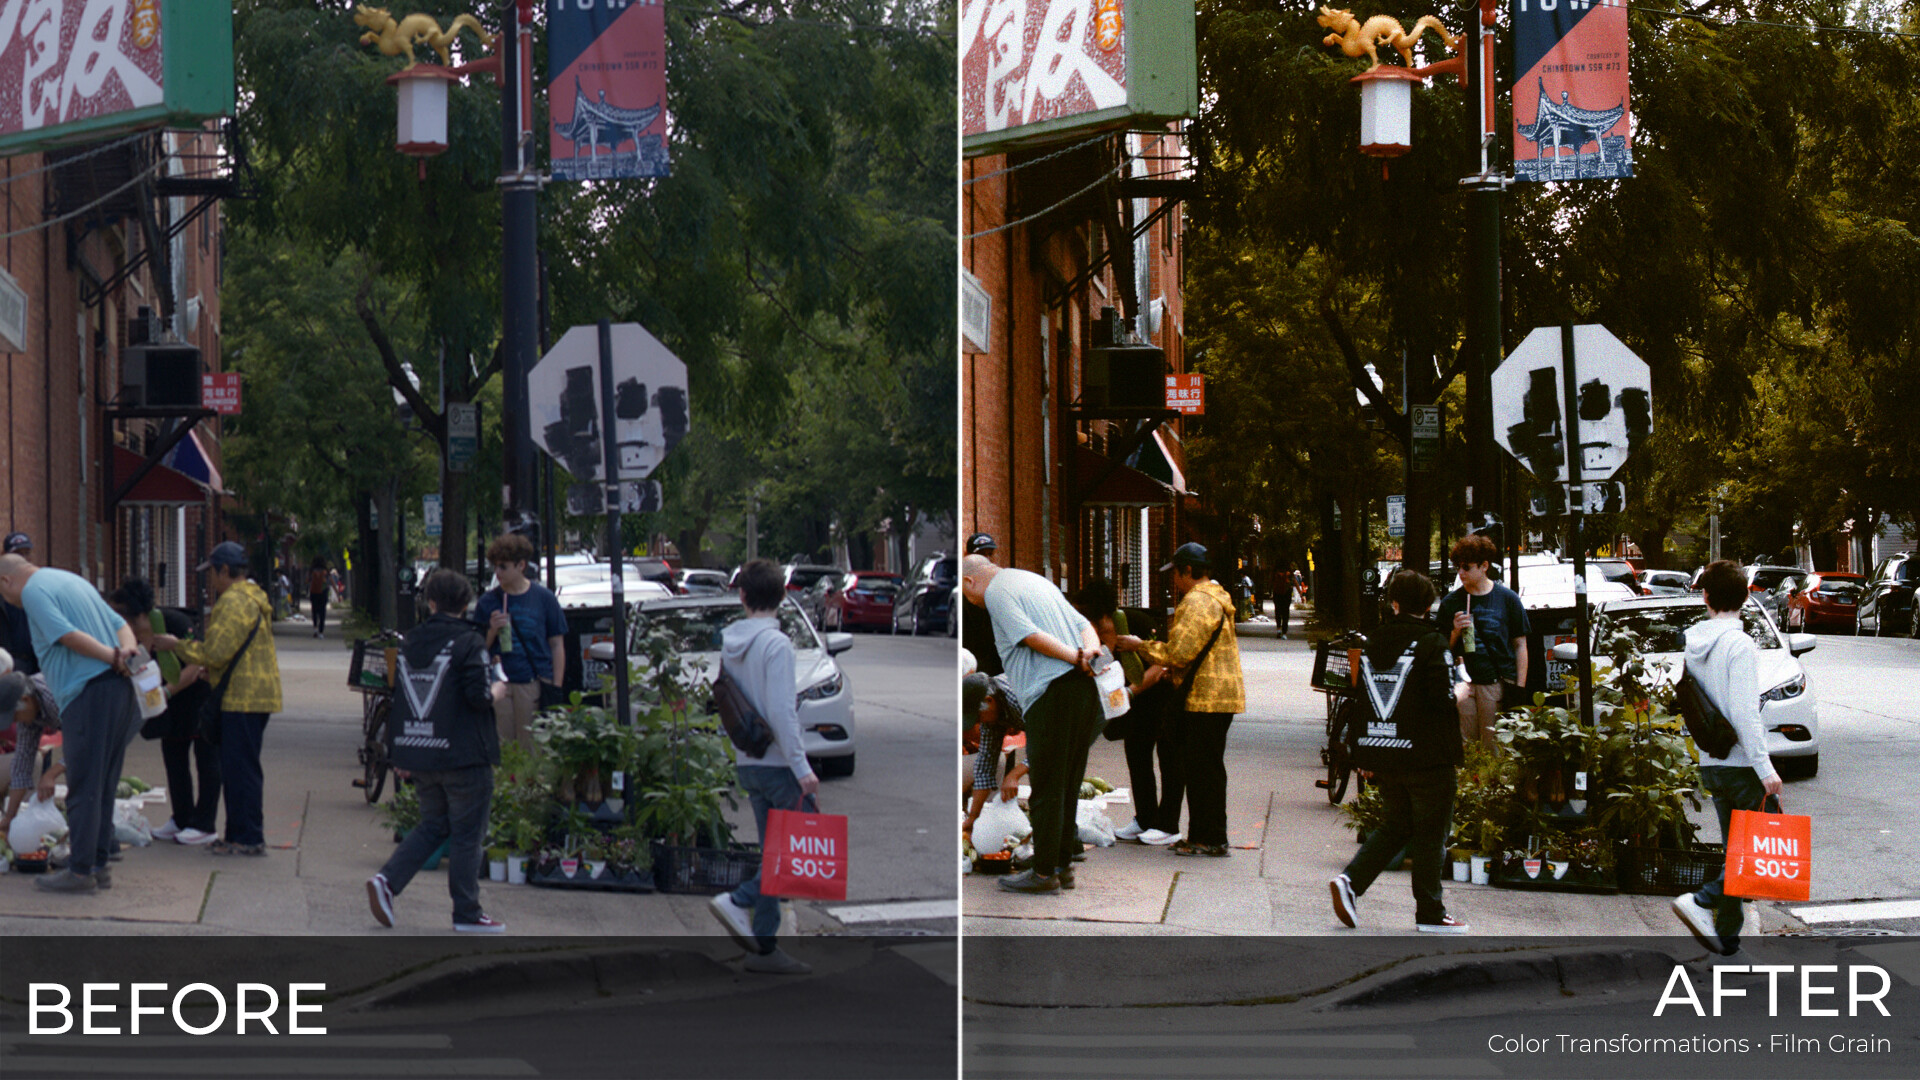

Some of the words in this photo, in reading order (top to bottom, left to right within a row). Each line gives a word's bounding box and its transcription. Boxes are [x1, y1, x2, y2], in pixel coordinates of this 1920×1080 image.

[1542, 63, 1586, 73] CHINATOWN
[1606, 61, 1620, 71] #73
[1372, 673, 1399, 682] HYPER
[790, 834, 835, 857] MINI
[1753, 835, 1798, 857] MINI
